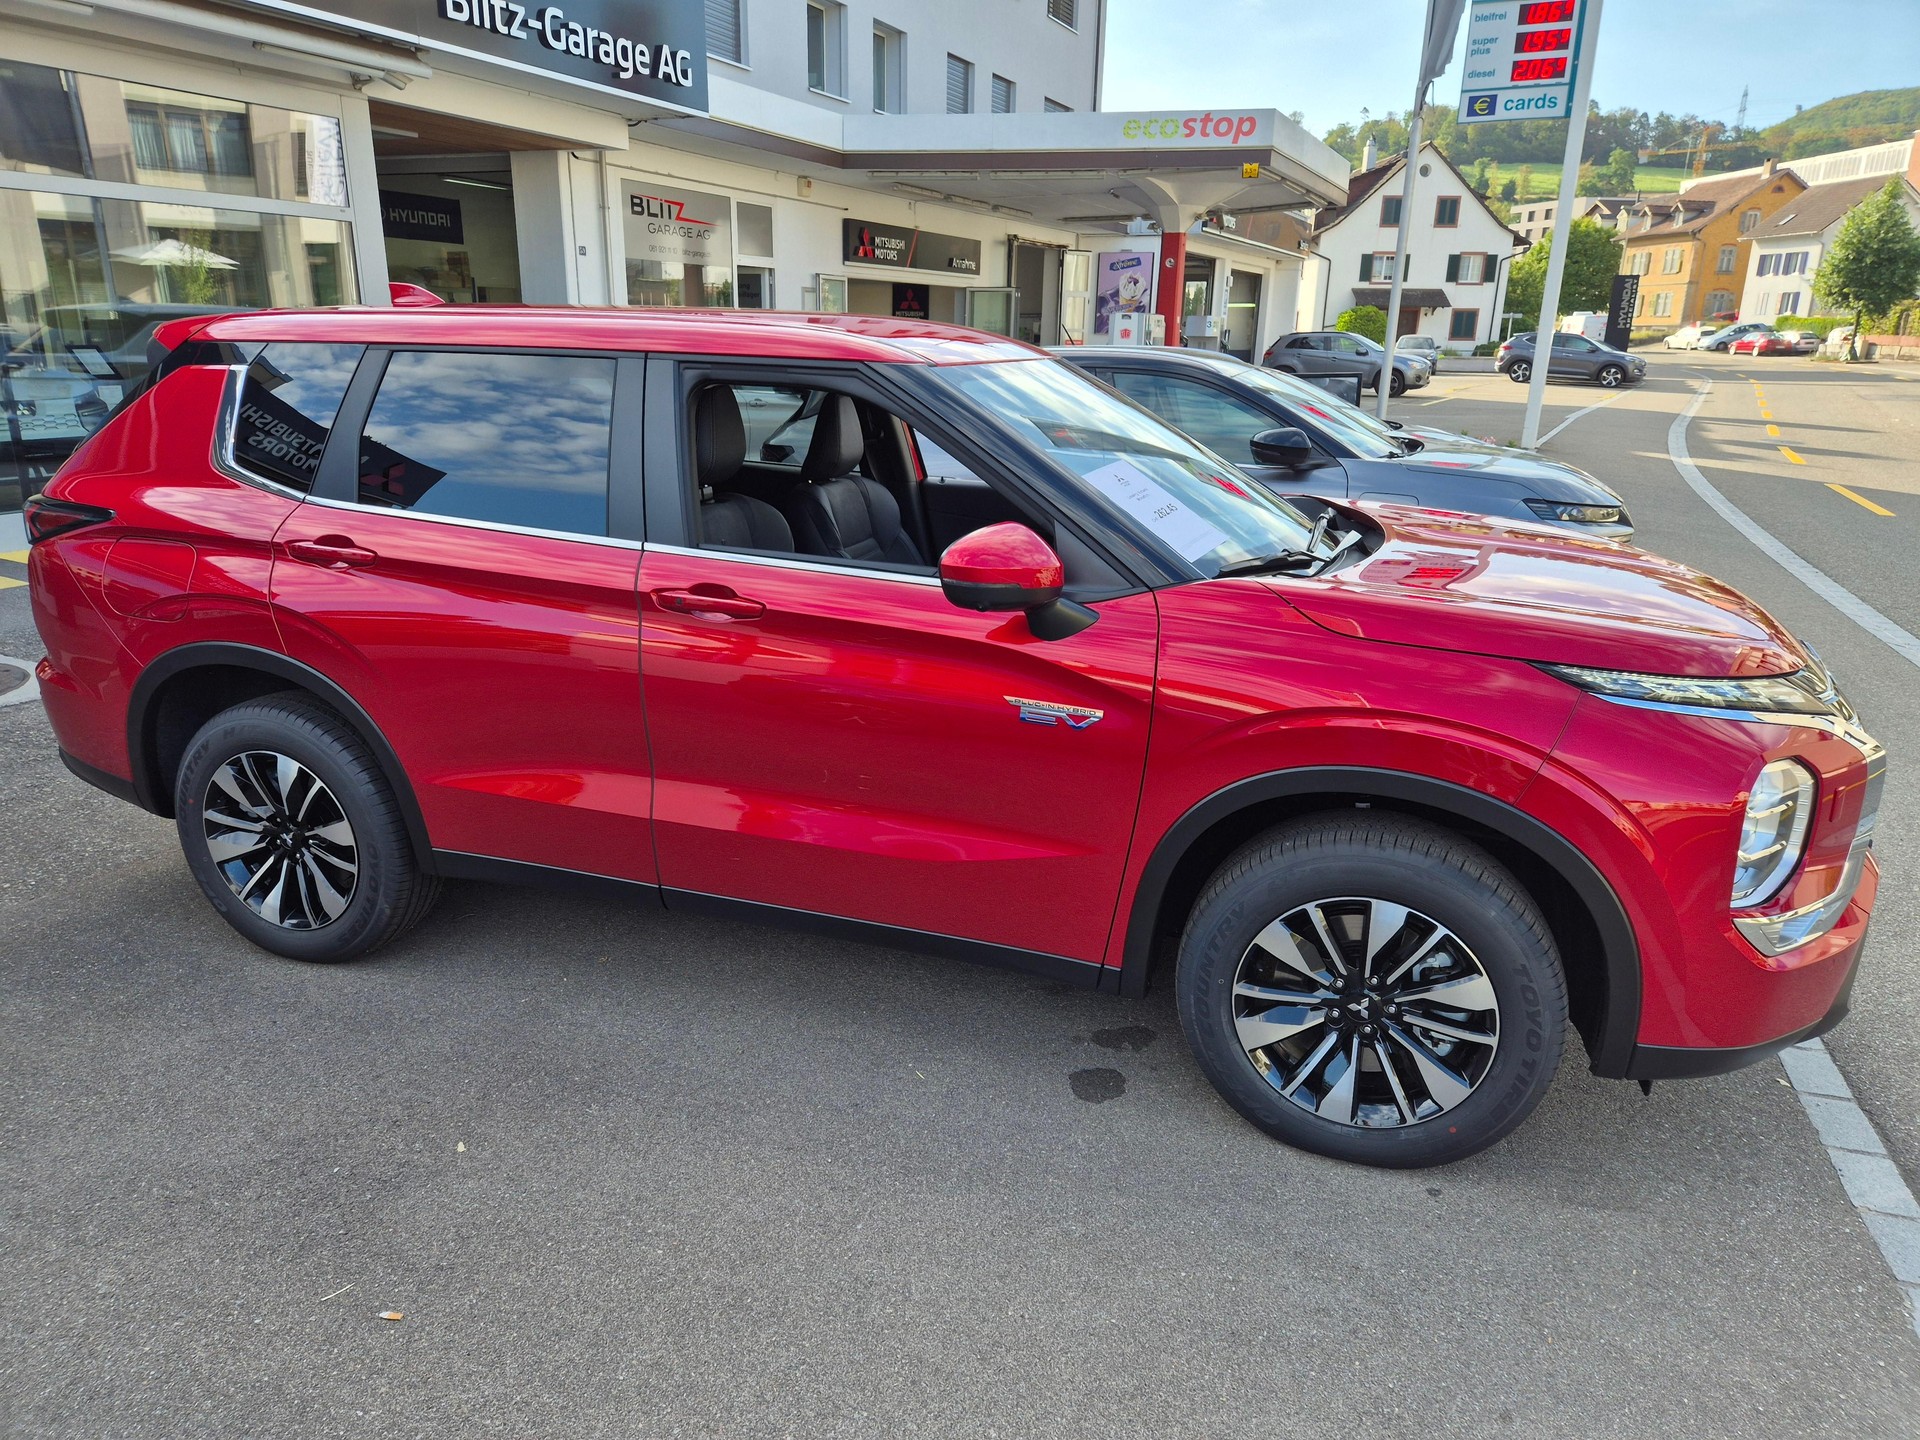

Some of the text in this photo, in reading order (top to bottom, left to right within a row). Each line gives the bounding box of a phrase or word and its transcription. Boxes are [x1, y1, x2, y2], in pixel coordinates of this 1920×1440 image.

[1474, 11, 1507, 23] bleifrei
[1471, 37, 1499, 47] super
[1470, 47, 1491, 57] plus
[658, 44, 693, 87] AG
[1467, 69, 1496, 79] diesel
[1503, 93, 1558, 112] cards
[1123, 112, 1257, 144] ecostop
[389, 207, 450, 228] HYUNDAI
[647, 222, 711, 240] GARAGE AG
[874, 236, 906, 250] MITSUBISHI
[874, 248, 898, 261] MOTORS
[952, 257, 976, 271] Annahme
[1617, 278, 1633, 328] HYUNDAI
[1206, 320, 1213, 329] 3
[1056, 705, 1097, 716] HYBRID
[1512, 963, 1543, 1053] TOYO
